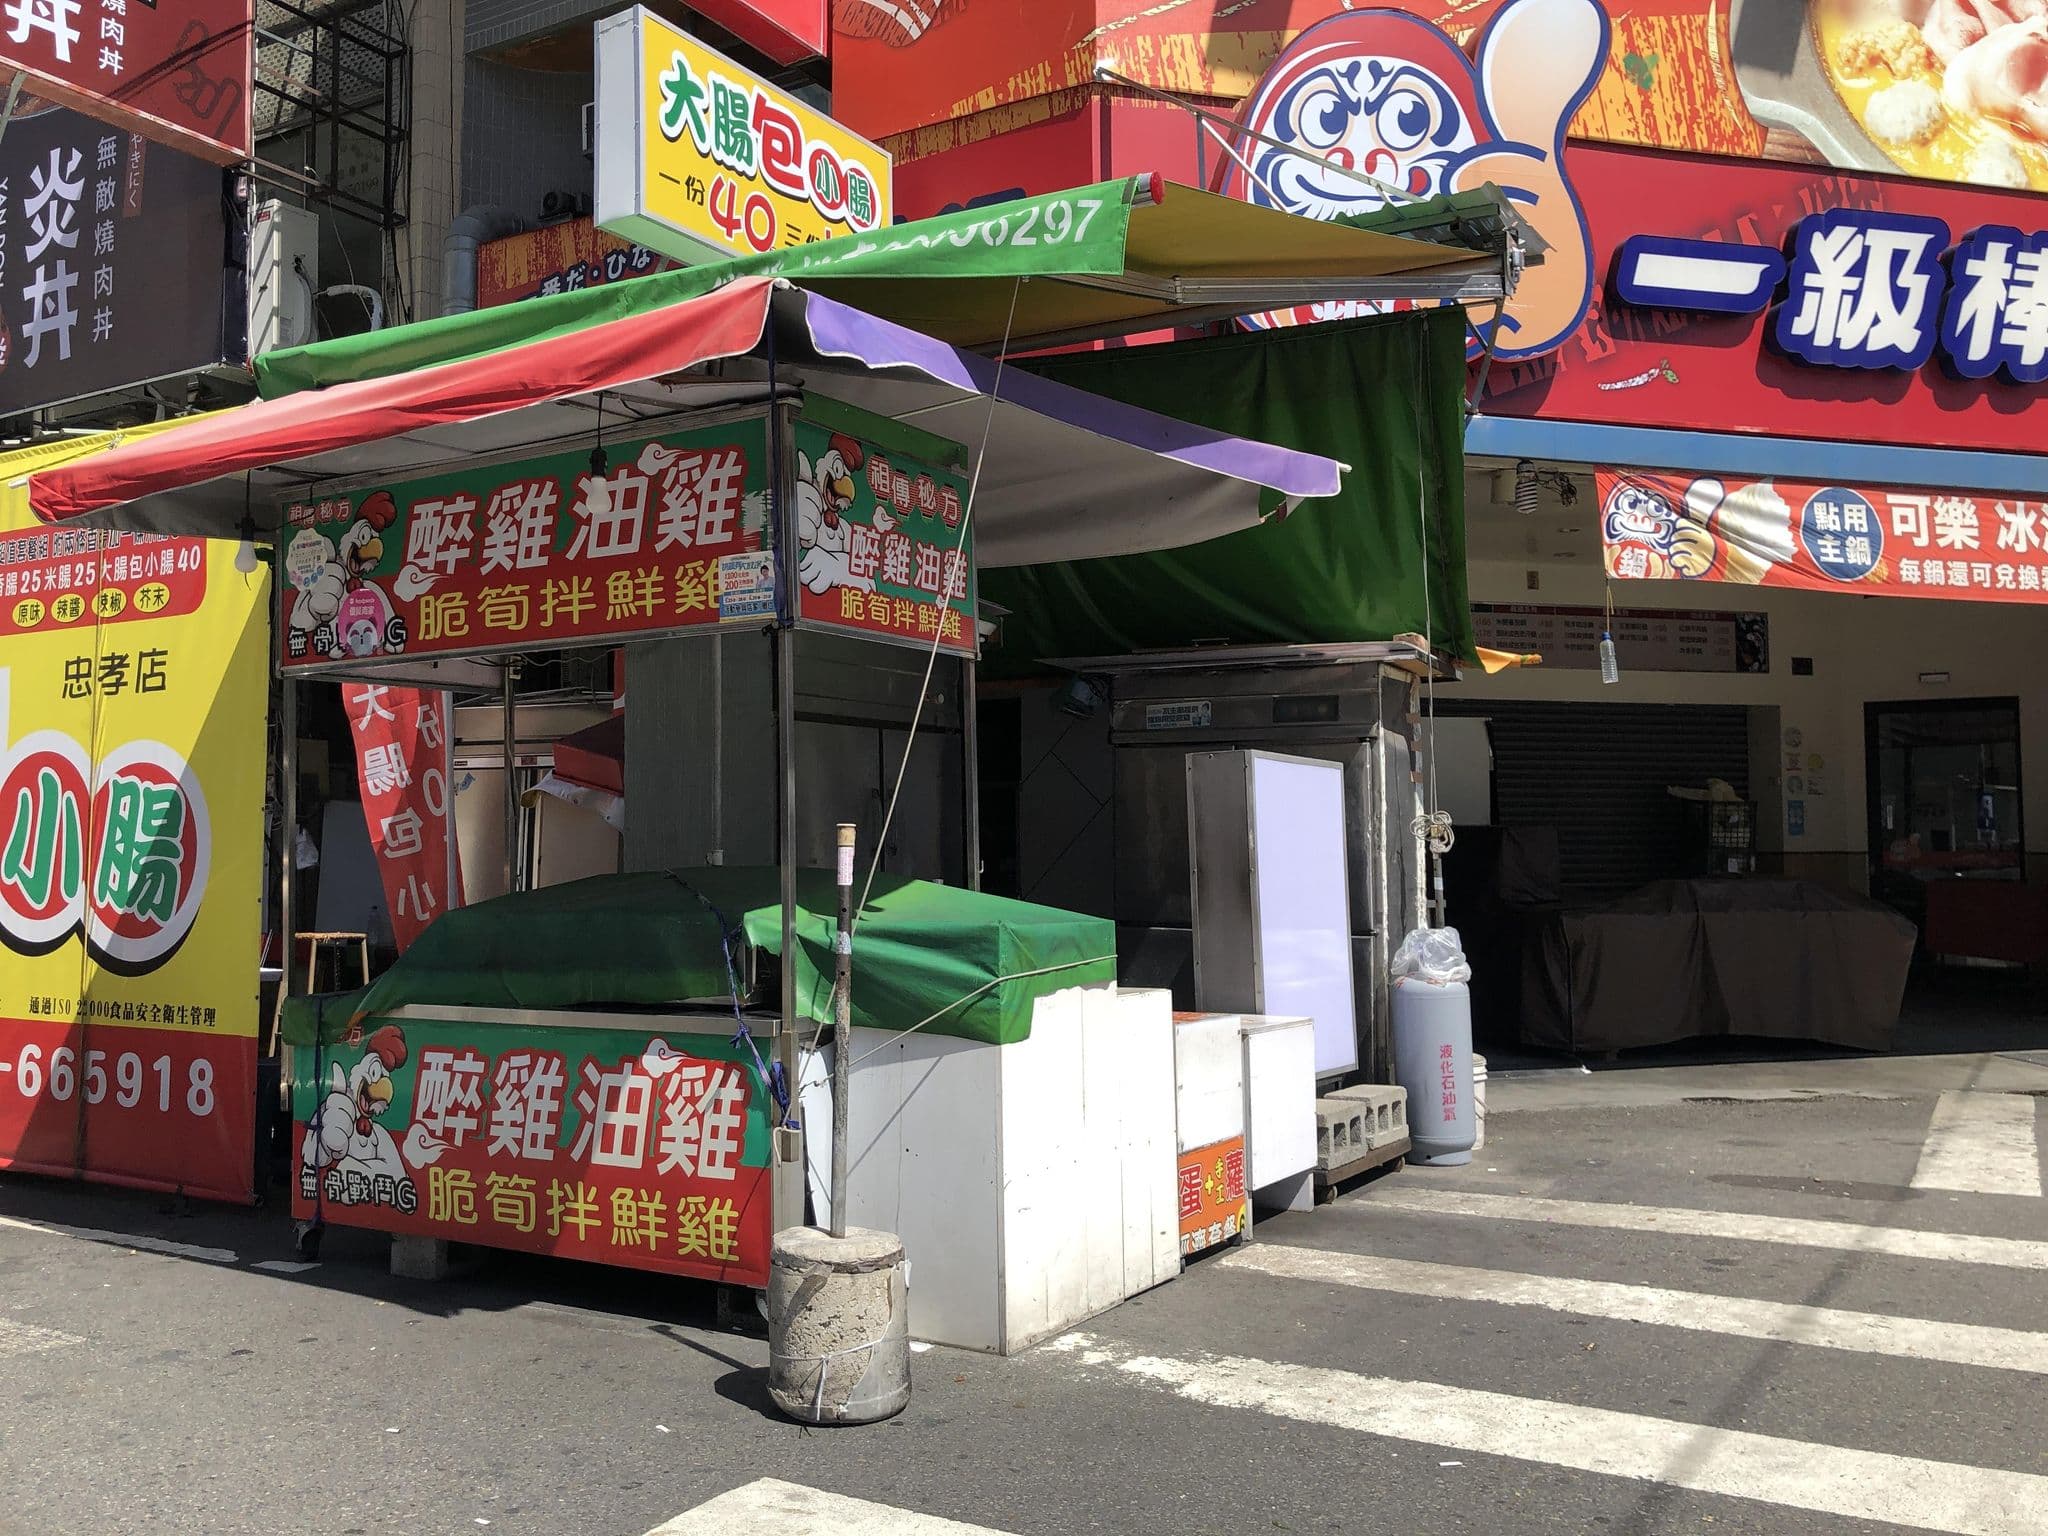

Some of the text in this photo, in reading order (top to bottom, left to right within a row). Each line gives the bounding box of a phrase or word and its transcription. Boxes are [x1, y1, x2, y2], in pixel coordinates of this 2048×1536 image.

[127, 133, 144, 208] やきにく
[664, 58, 874, 229] 大腸包小腸
[93, 135, 117, 343] 無敵燒肉丼
[659, 172, 705, 206] 一份
[709, 176, 776, 252] 40
[22, 147, 86, 369] 炎丼
[1633, 225, 2048, 367] 一級棒
[289, 501, 350, 526] 祖傳秘方
[406, 450, 744, 576] 醉雞油雞
[871, 459, 960, 522] 祖傳秘方
[1813, 501, 1869, 533] 點用
[1886, 494, 2048, 554] 可樂 冰
[850, 524, 967, 599] 醉雞油雞
[1817, 534, 1873, 566] 主鍋
[18, 603, 41, 624] 原味
[140, 587, 166, 608] 芥末
[841, 587, 962, 641] 脆筍拌鮮雞
[62, 648, 169, 700] 忠孝店
[4, 770, 185, 923] 小腸
[415, 1050, 745, 1182] 醉雞油雞
[427, 1165, 741, 1263] 脆筍拌鮮雞
